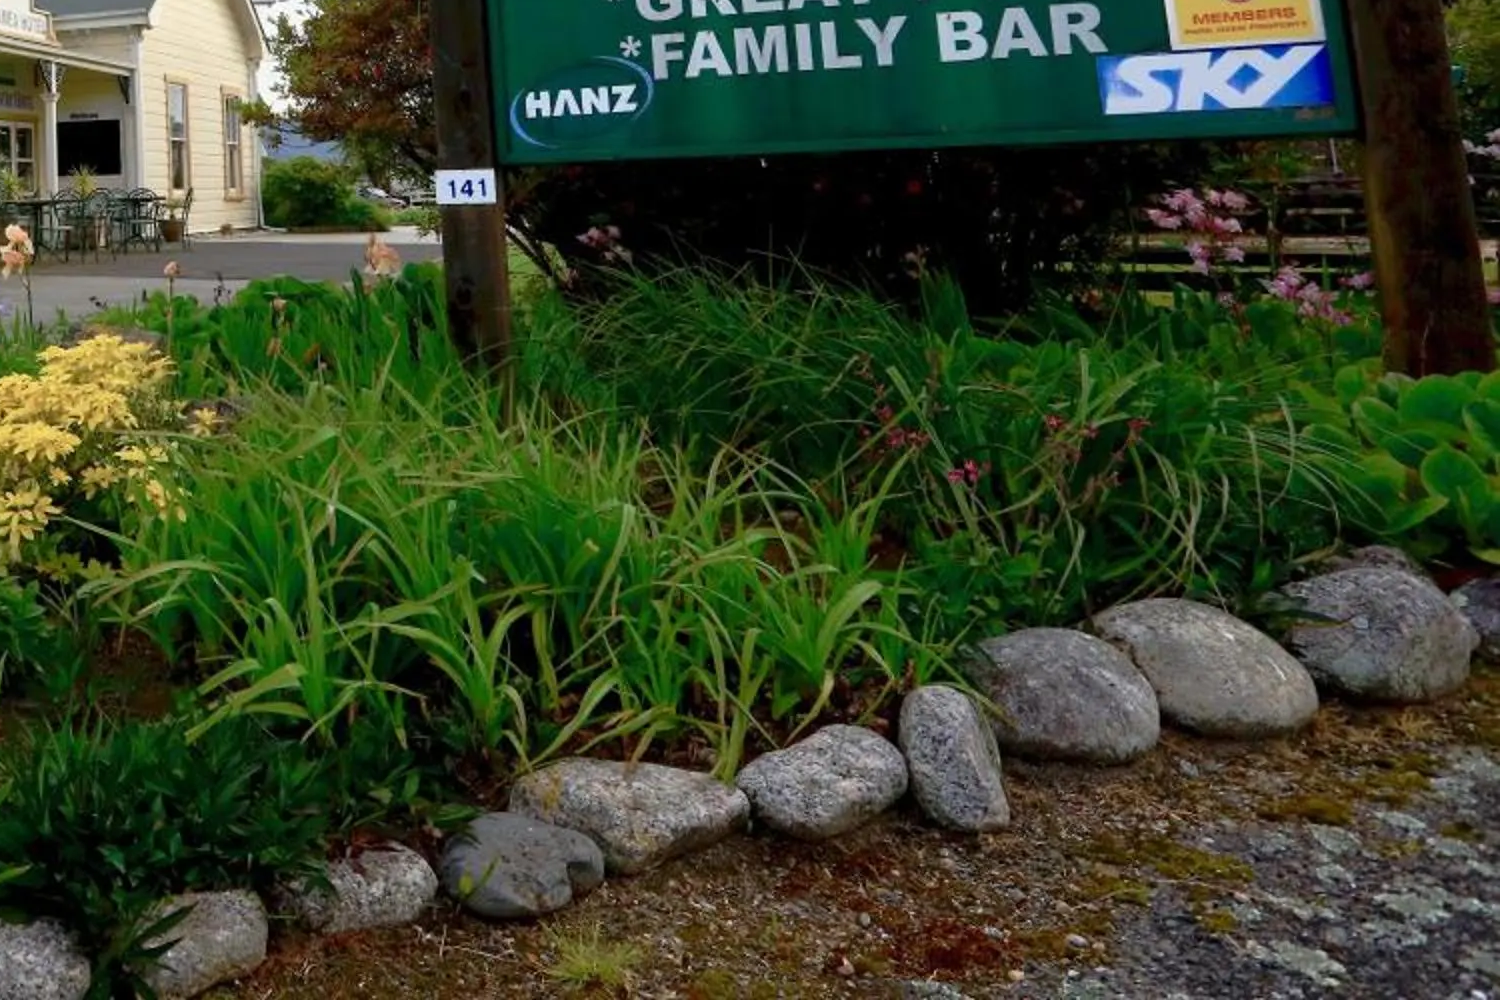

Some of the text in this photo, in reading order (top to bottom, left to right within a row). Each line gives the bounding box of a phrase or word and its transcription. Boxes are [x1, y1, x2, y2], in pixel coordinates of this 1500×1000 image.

[935, 2, 1108, 62] BAR
[1192, 7, 1297, 25] MEMBERS
[1105, 43, 1326, 114] SKY
[525, 84, 637, 119] HANZ
[448, 178, 487, 198] 141
